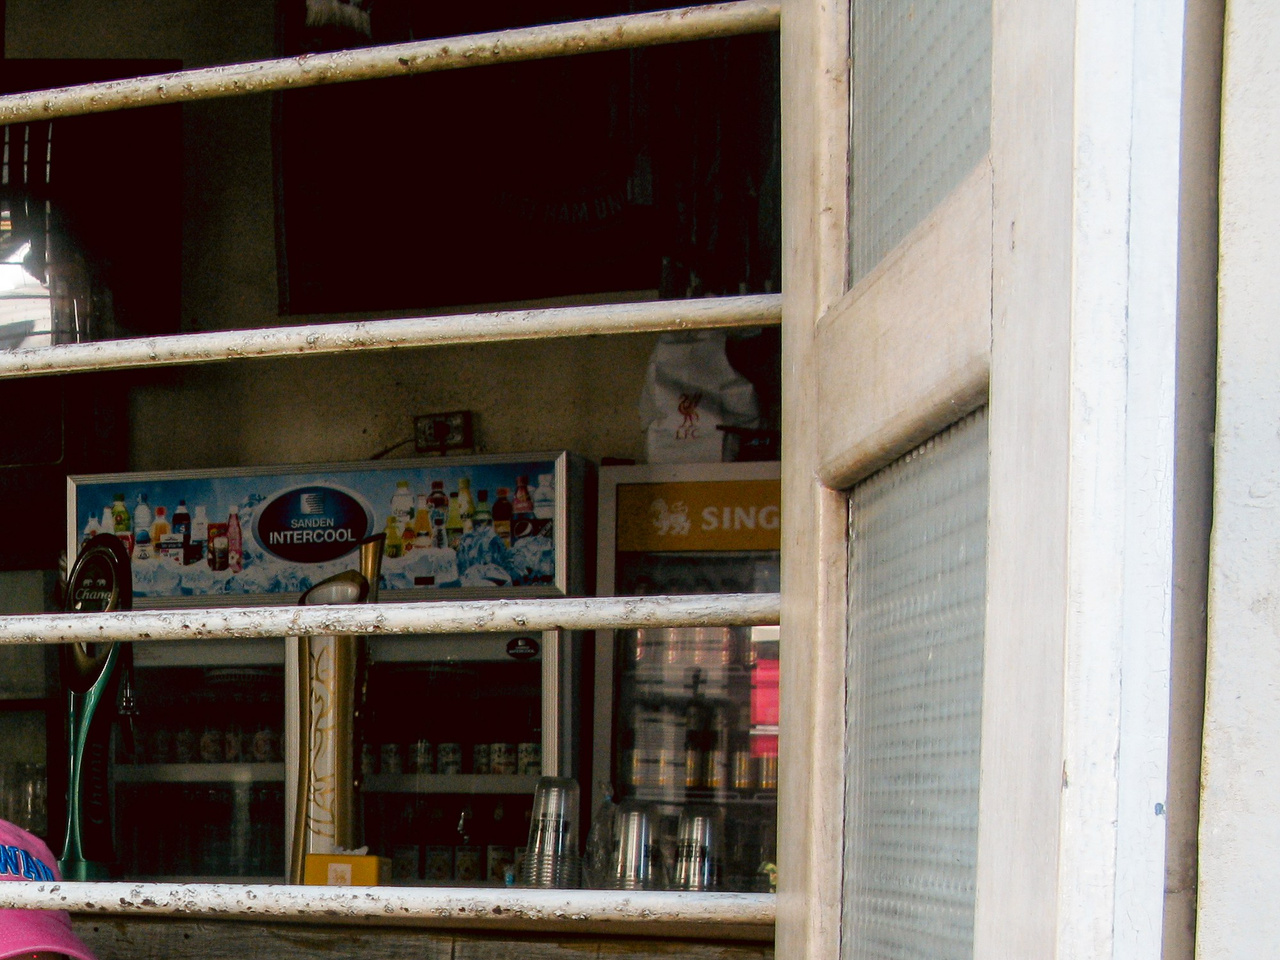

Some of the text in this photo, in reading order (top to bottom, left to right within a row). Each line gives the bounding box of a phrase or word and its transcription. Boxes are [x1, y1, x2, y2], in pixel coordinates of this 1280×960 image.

[290, 517, 335, 529] SANDEN
[701, 506, 779, 530] SING
[269, 528, 357, 545] INTERCOOL
